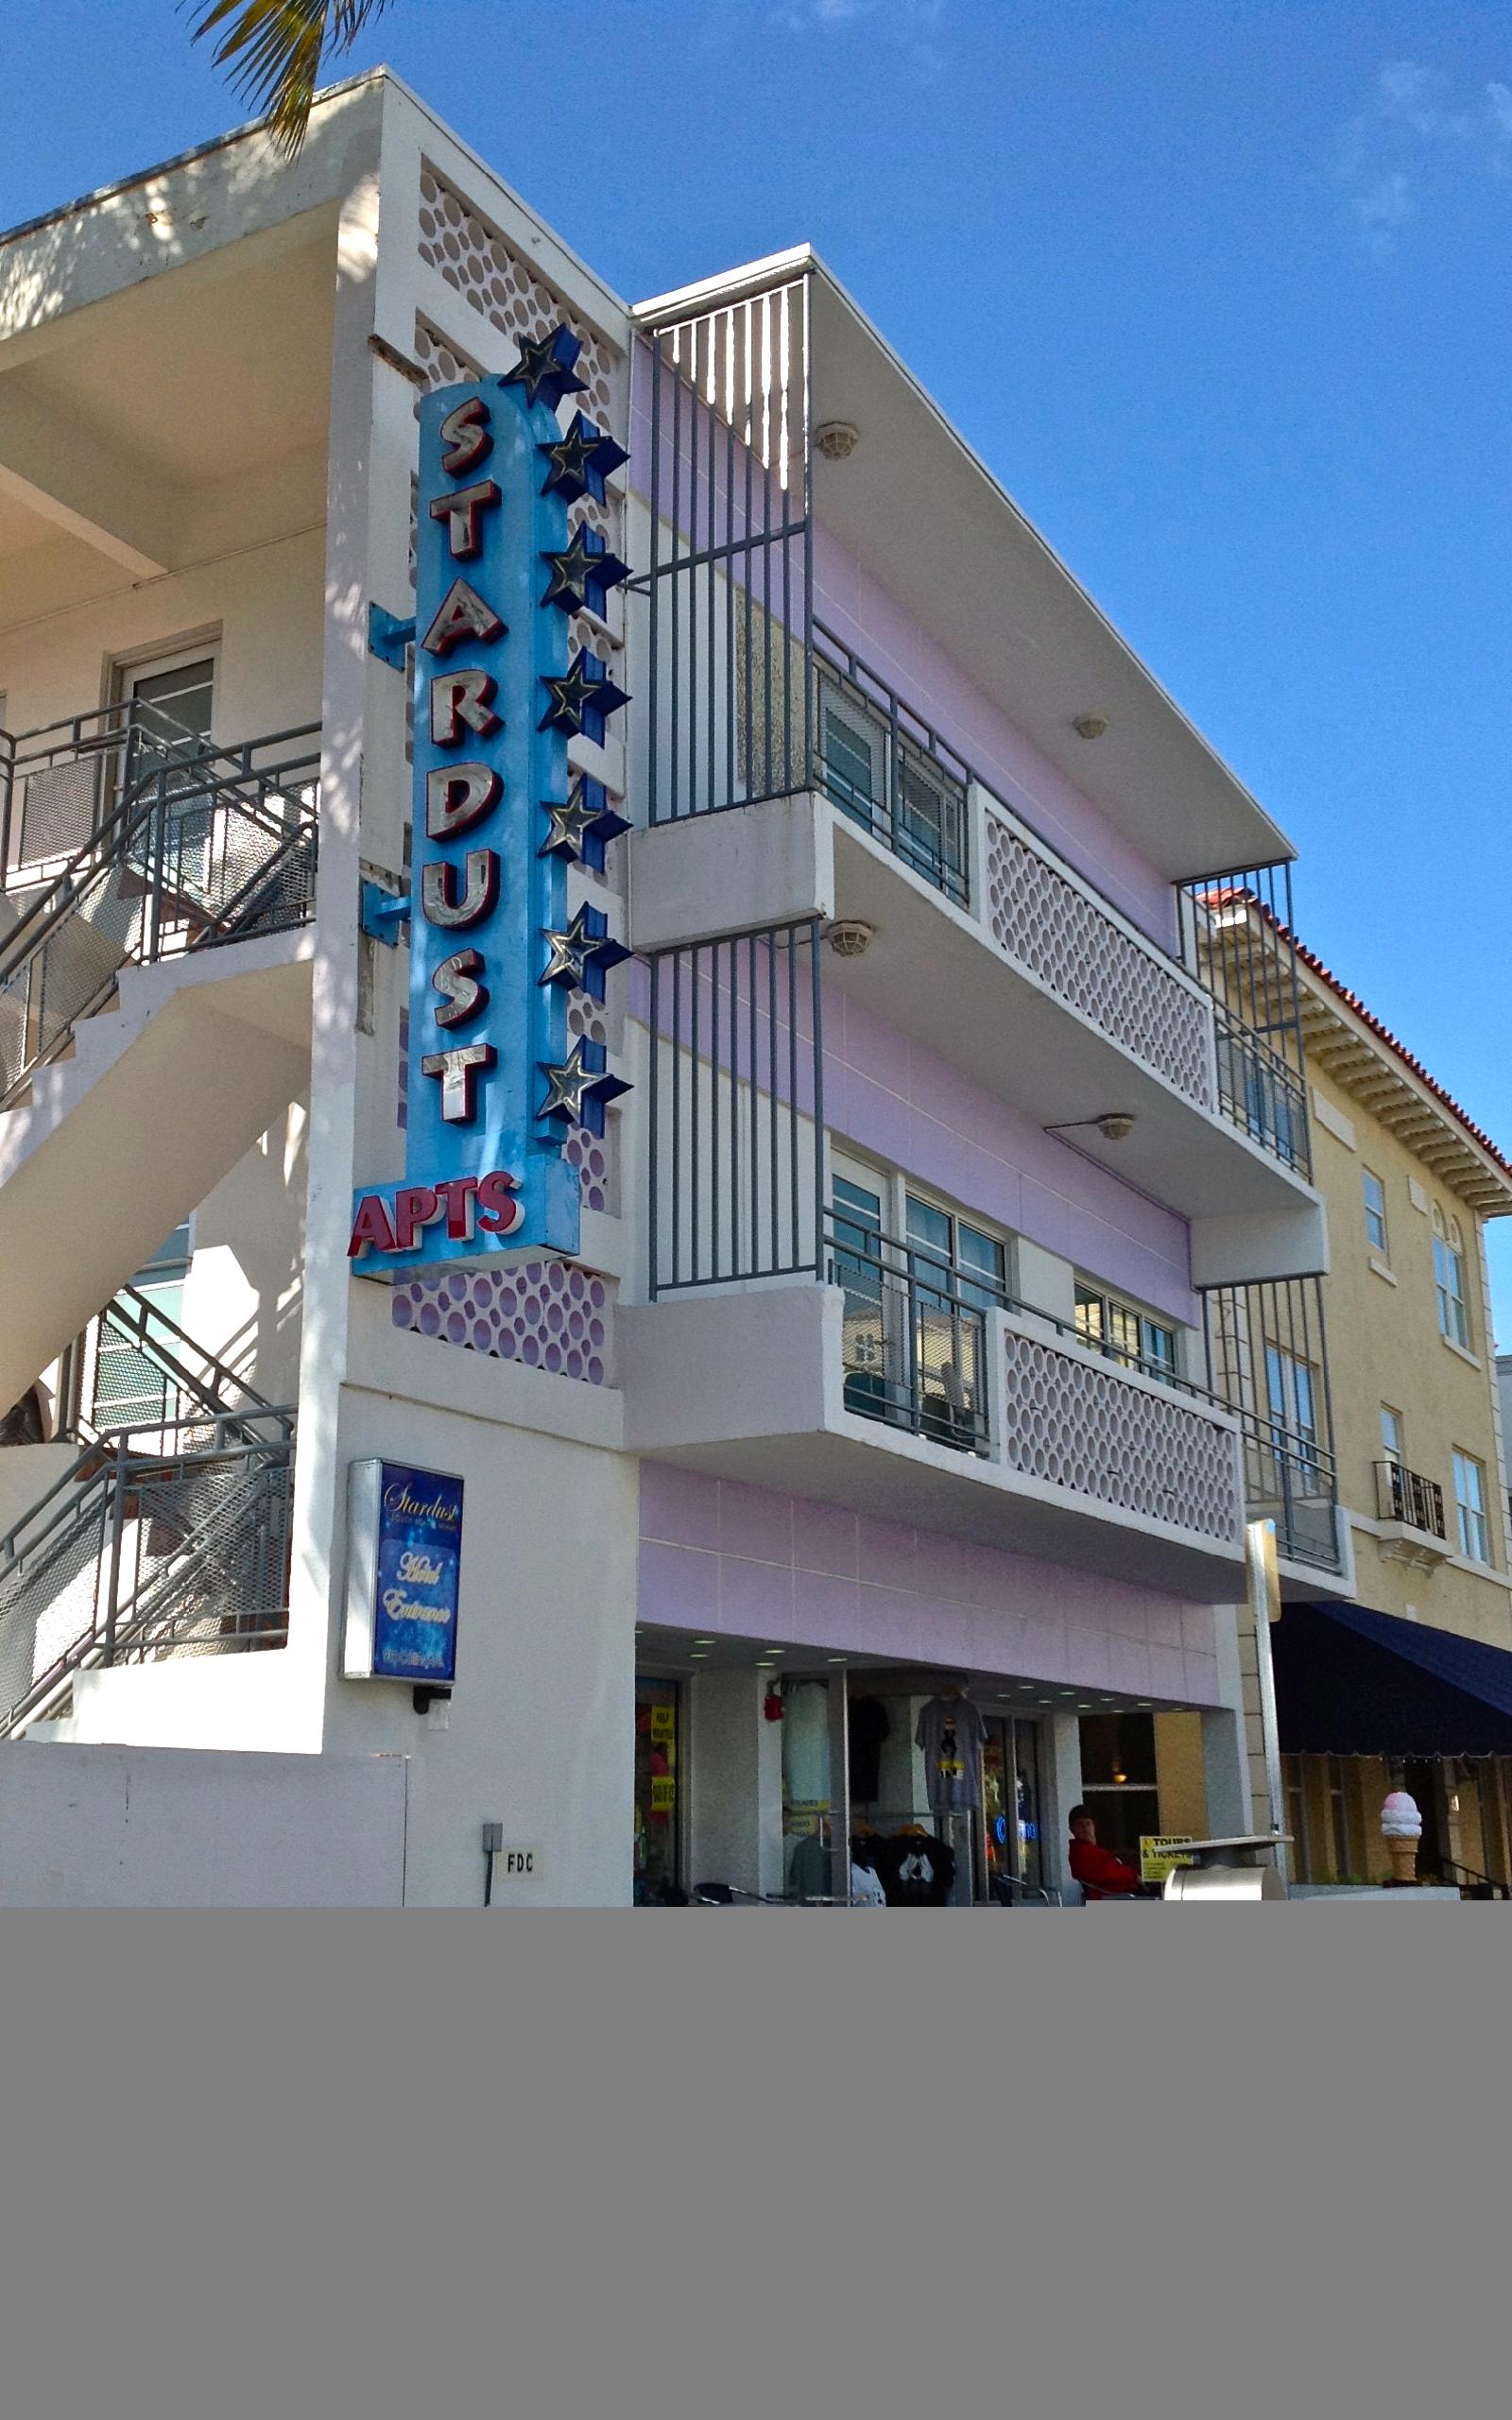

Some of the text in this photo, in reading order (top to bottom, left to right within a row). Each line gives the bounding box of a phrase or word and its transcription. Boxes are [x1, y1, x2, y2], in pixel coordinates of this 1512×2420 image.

[421, 396, 509, 1124] STARDUST
[347, 1170, 523, 1259] APTS
[384, 1483, 458, 1521] Stardust
[397, 1552, 443, 1585] Hotel
[383, 1588, 451, 1623] Entrance
[507, 1852, 534, 1873] FDC
